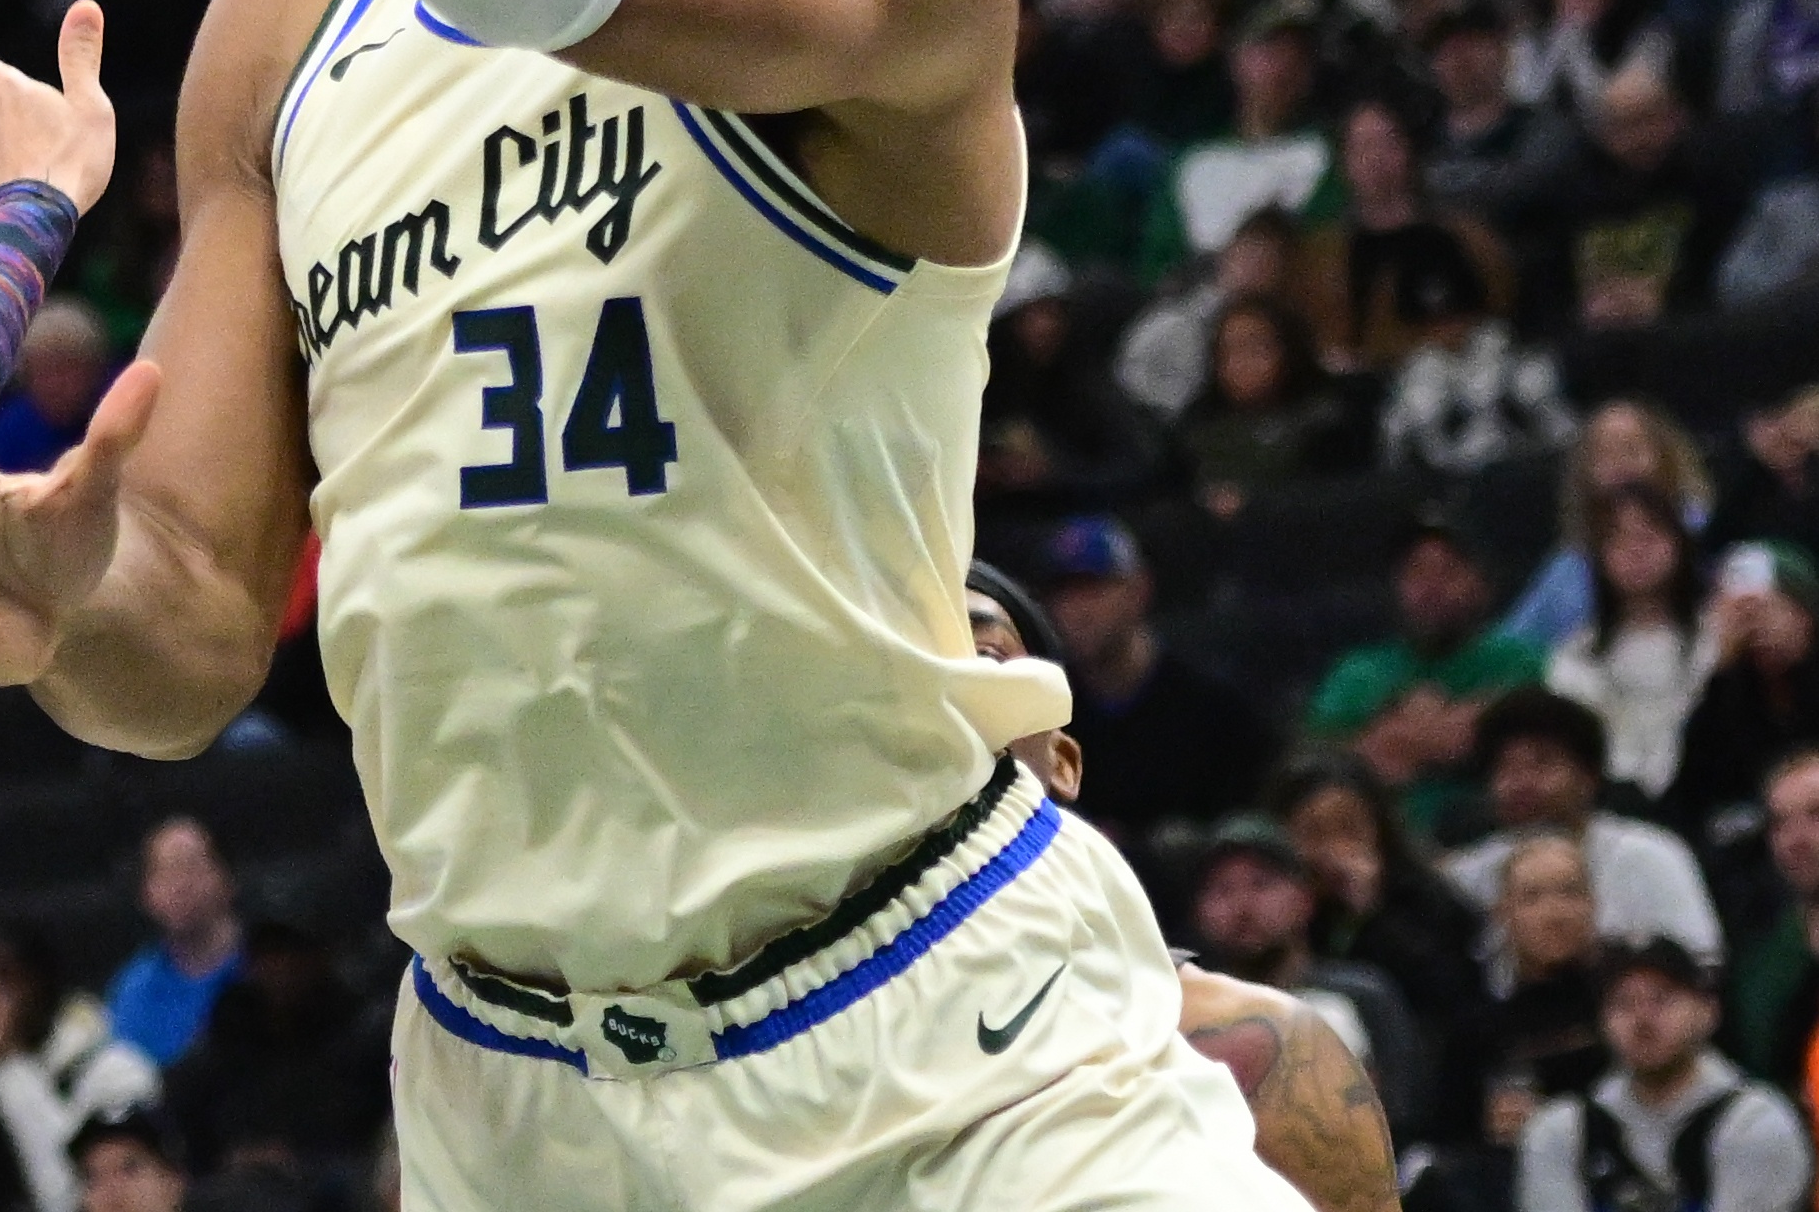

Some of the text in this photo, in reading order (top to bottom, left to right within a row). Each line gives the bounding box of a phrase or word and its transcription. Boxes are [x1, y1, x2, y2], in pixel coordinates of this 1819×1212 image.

[478, 92, 663, 265] City
[452, 295, 679, 510] 34
[608, 1018, 661, 1047] BUCKS
